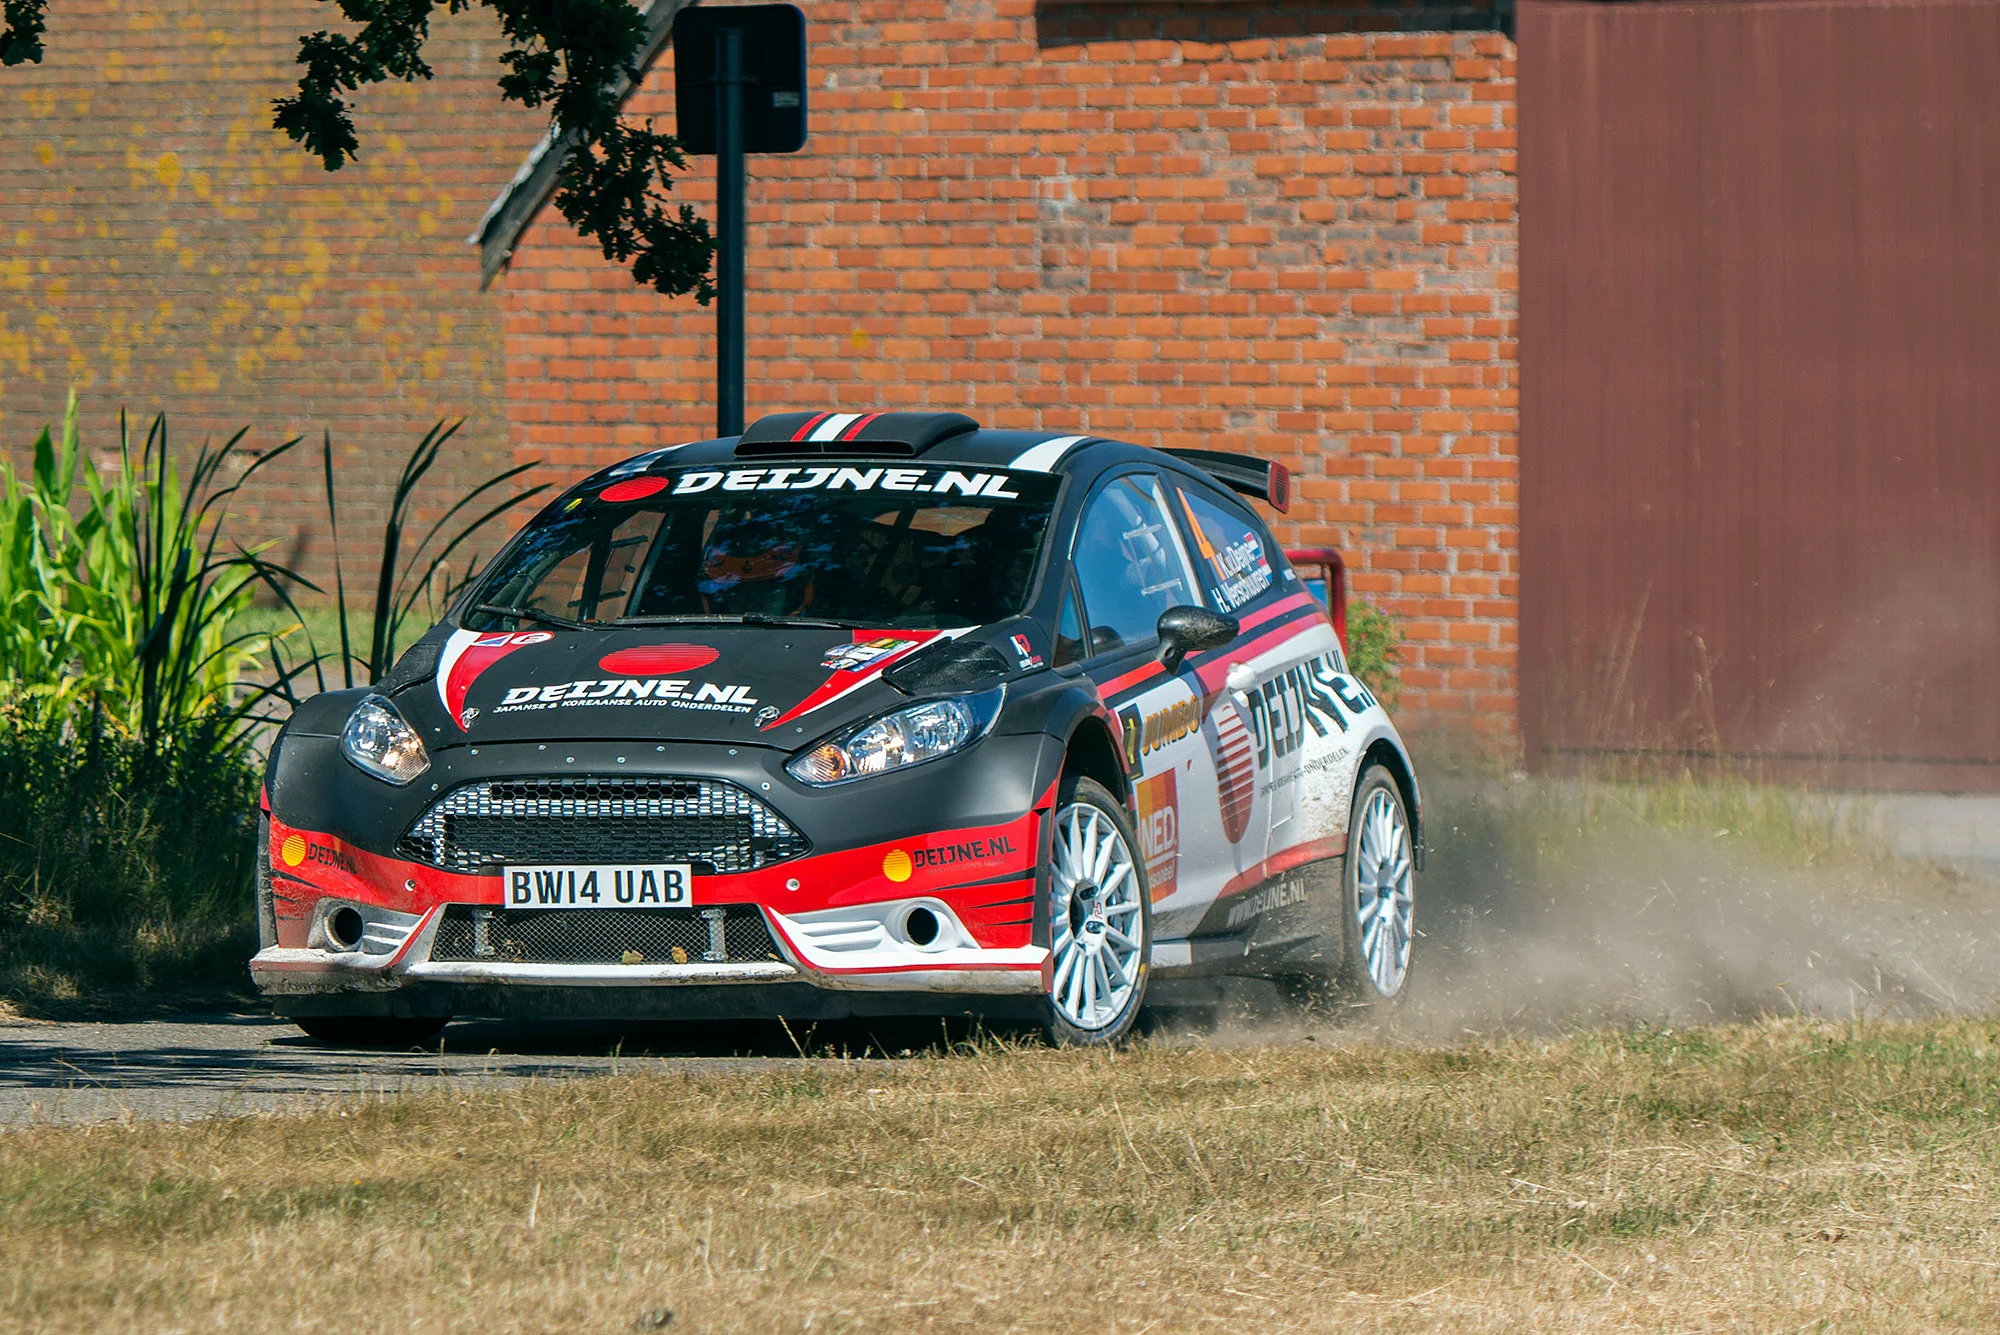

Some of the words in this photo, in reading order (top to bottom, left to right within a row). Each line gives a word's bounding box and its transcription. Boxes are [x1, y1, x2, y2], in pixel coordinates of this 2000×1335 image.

[672, 467, 1019, 499] DEIJNE.NL
[1211, 587, 1232, 614] H.
[492, 703, 546, 714] JAPANSE
[561, 699, 635, 708] KOREAANSE
[636, 699, 669, 708] AUTO
[670, 700, 752, 714] ONDERDELEN
[501, 679, 759, 705] DEIJNE.NL
[1142, 694, 1199, 757] JUMBO
[913, 835, 1017, 869] DEIJNE.NL
[614, 869, 685, 903] UAB
